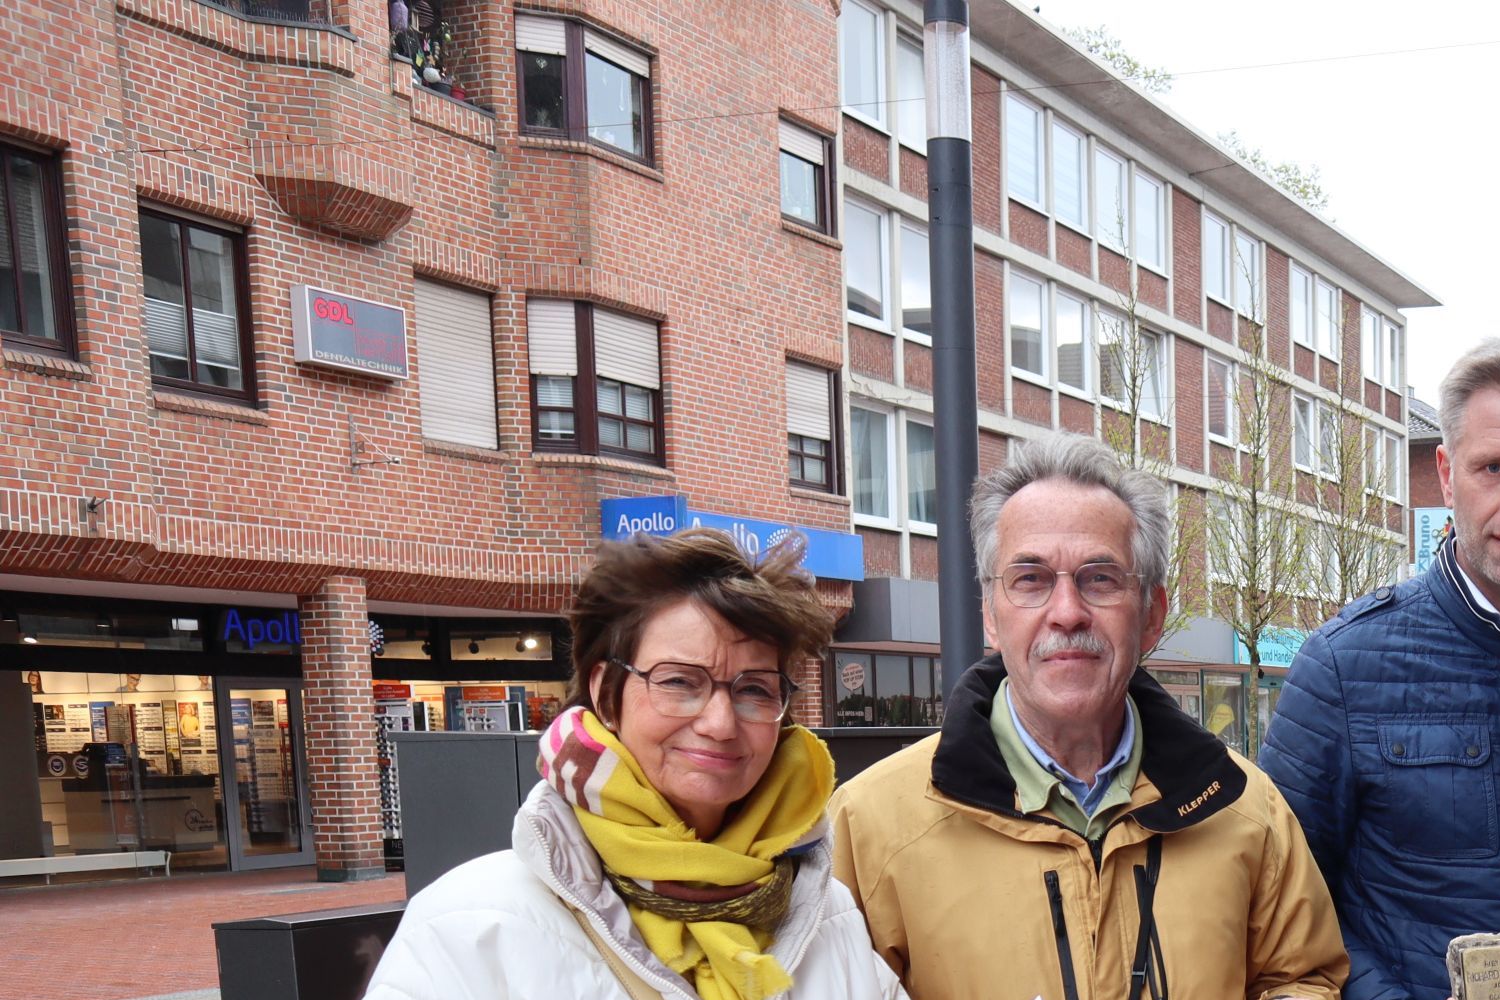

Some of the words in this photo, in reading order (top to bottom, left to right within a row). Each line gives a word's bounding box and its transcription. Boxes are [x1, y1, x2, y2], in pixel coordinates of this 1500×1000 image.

[313, 297, 353, 325] GDL
[315, 350, 404, 374] DENTALTECHNIK
[617, 512, 675, 537] Apollo
[1419, 515, 1430, 559] Bruno
[224, 608, 301, 649] Apoll
[1261, 650, 1273, 661] und
[1177, 781, 1221, 817] KLEPPER
